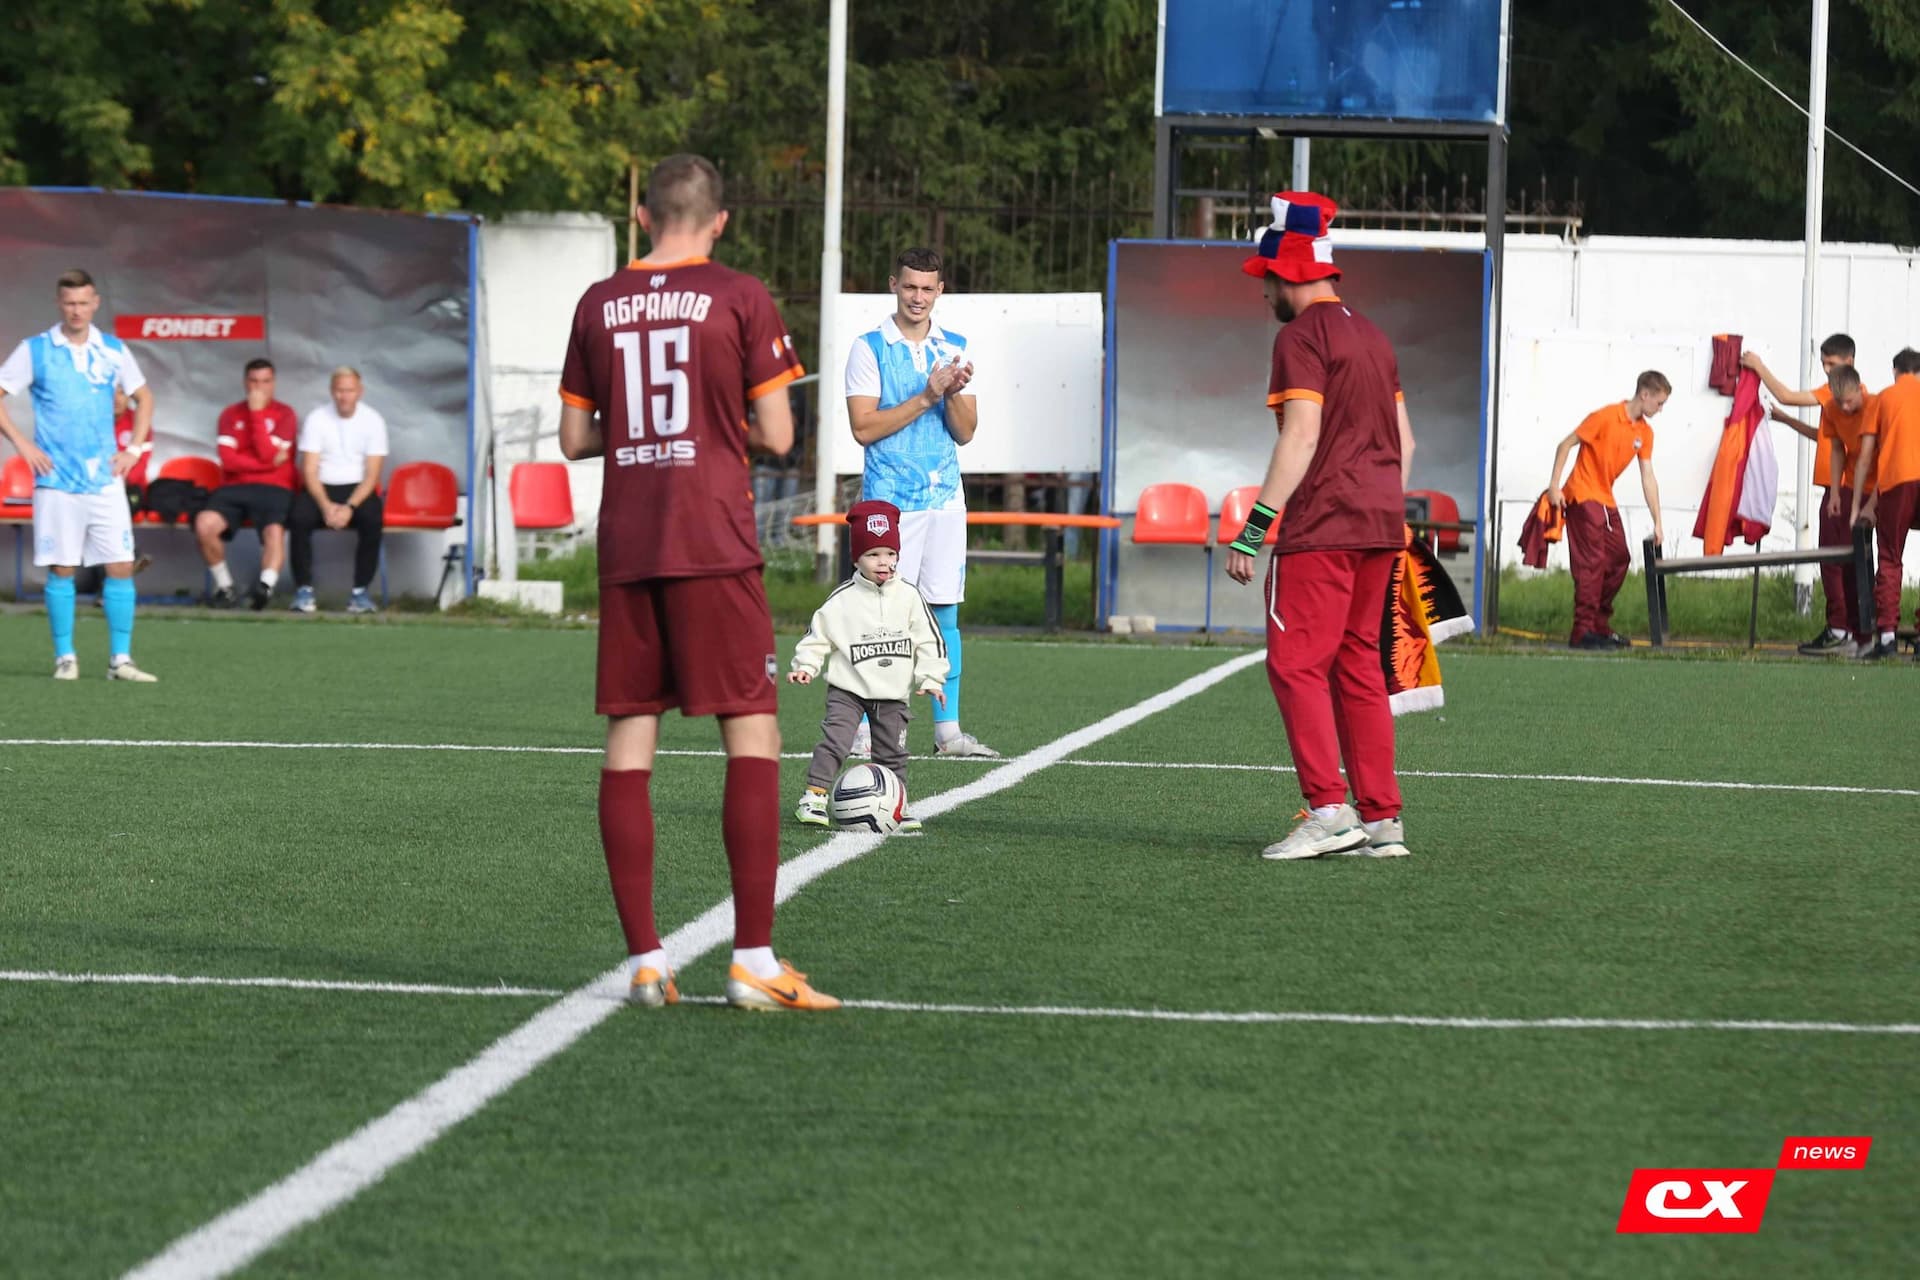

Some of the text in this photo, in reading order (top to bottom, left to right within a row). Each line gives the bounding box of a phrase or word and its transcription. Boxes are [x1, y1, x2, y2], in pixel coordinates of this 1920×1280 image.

[603, 291, 712, 329] АБРАМОВ
[142, 317, 236, 337] FONBET
[613, 325, 690, 439] 15
[615, 440, 696, 466] SEUS
[852, 639, 911, 662] NOSTALGIA
